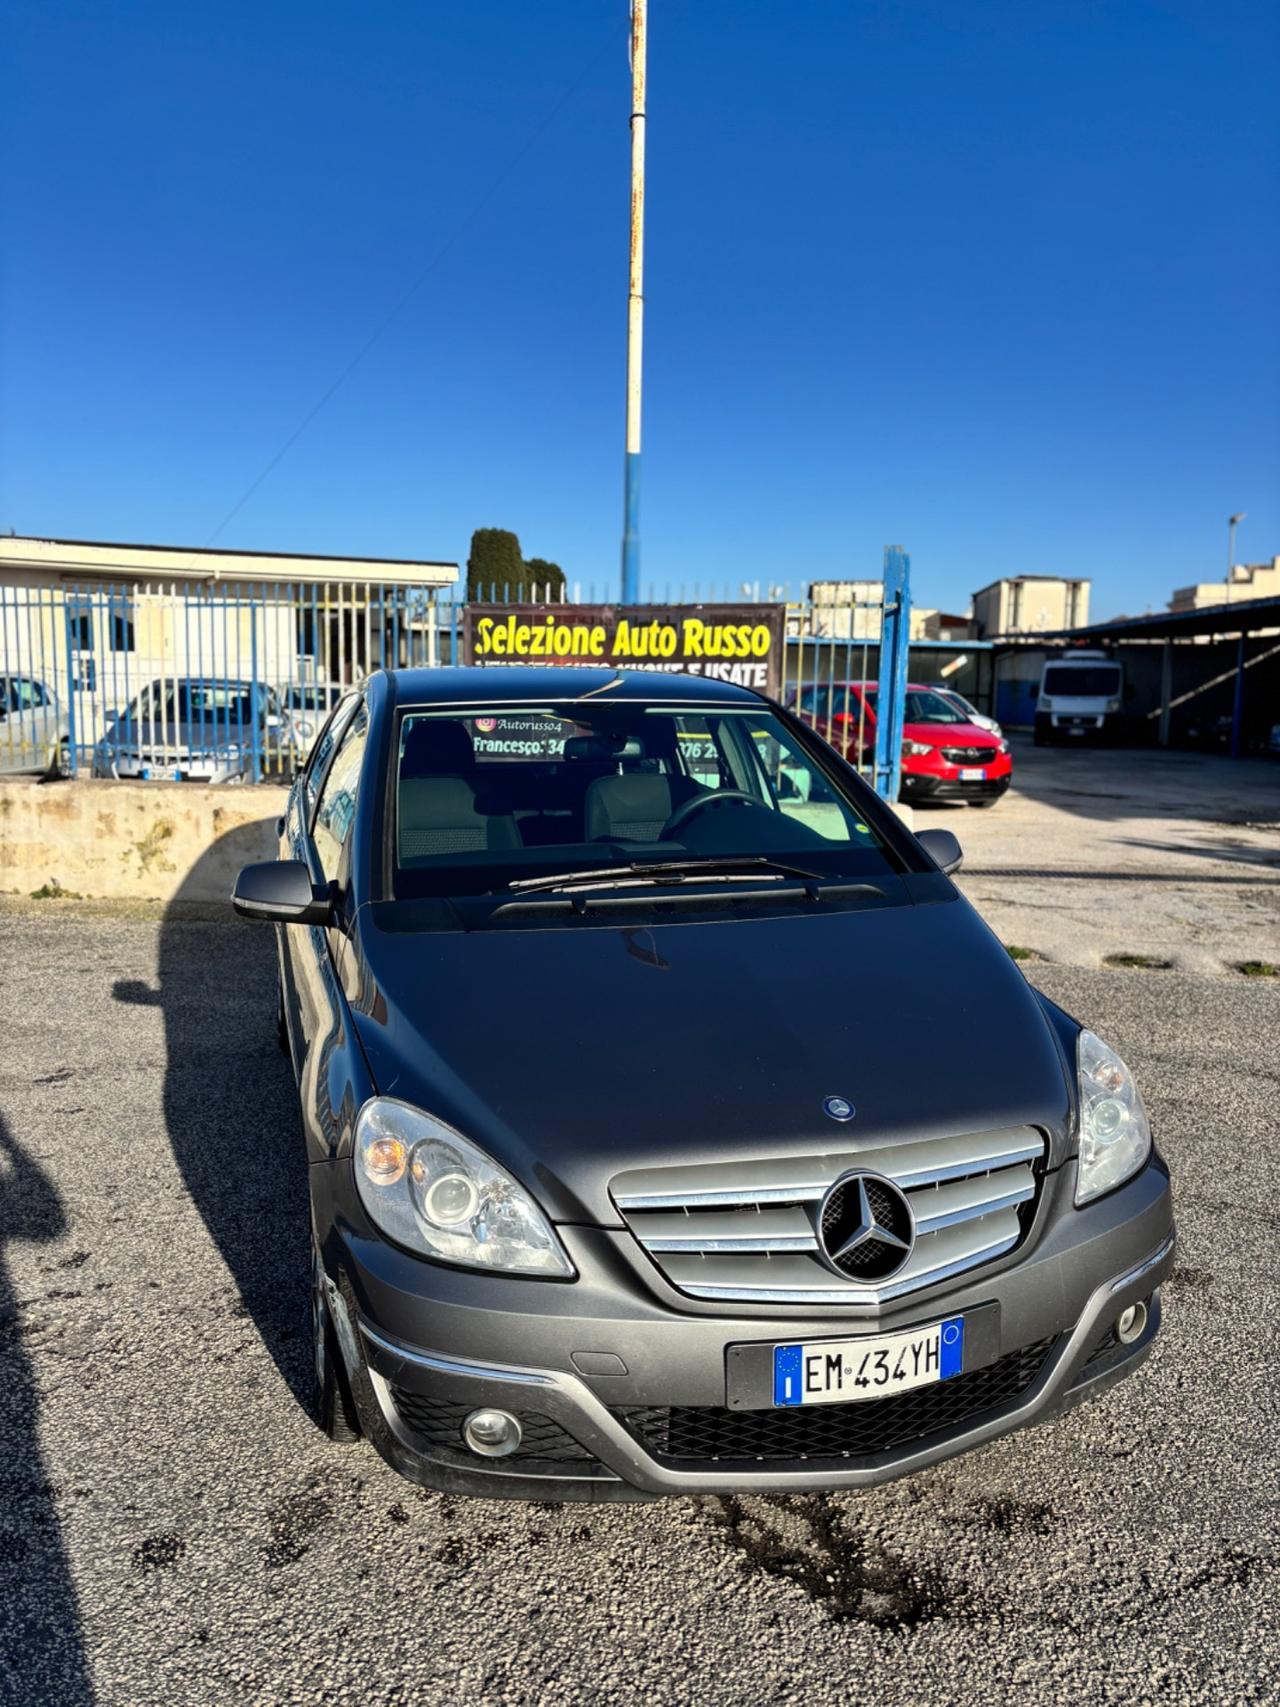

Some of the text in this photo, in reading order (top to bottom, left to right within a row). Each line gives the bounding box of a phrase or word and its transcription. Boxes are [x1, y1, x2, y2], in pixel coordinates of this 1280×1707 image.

[474, 615, 771, 657] Selezione Auto Russo
[498, 719, 562, 732] Autorusso4
